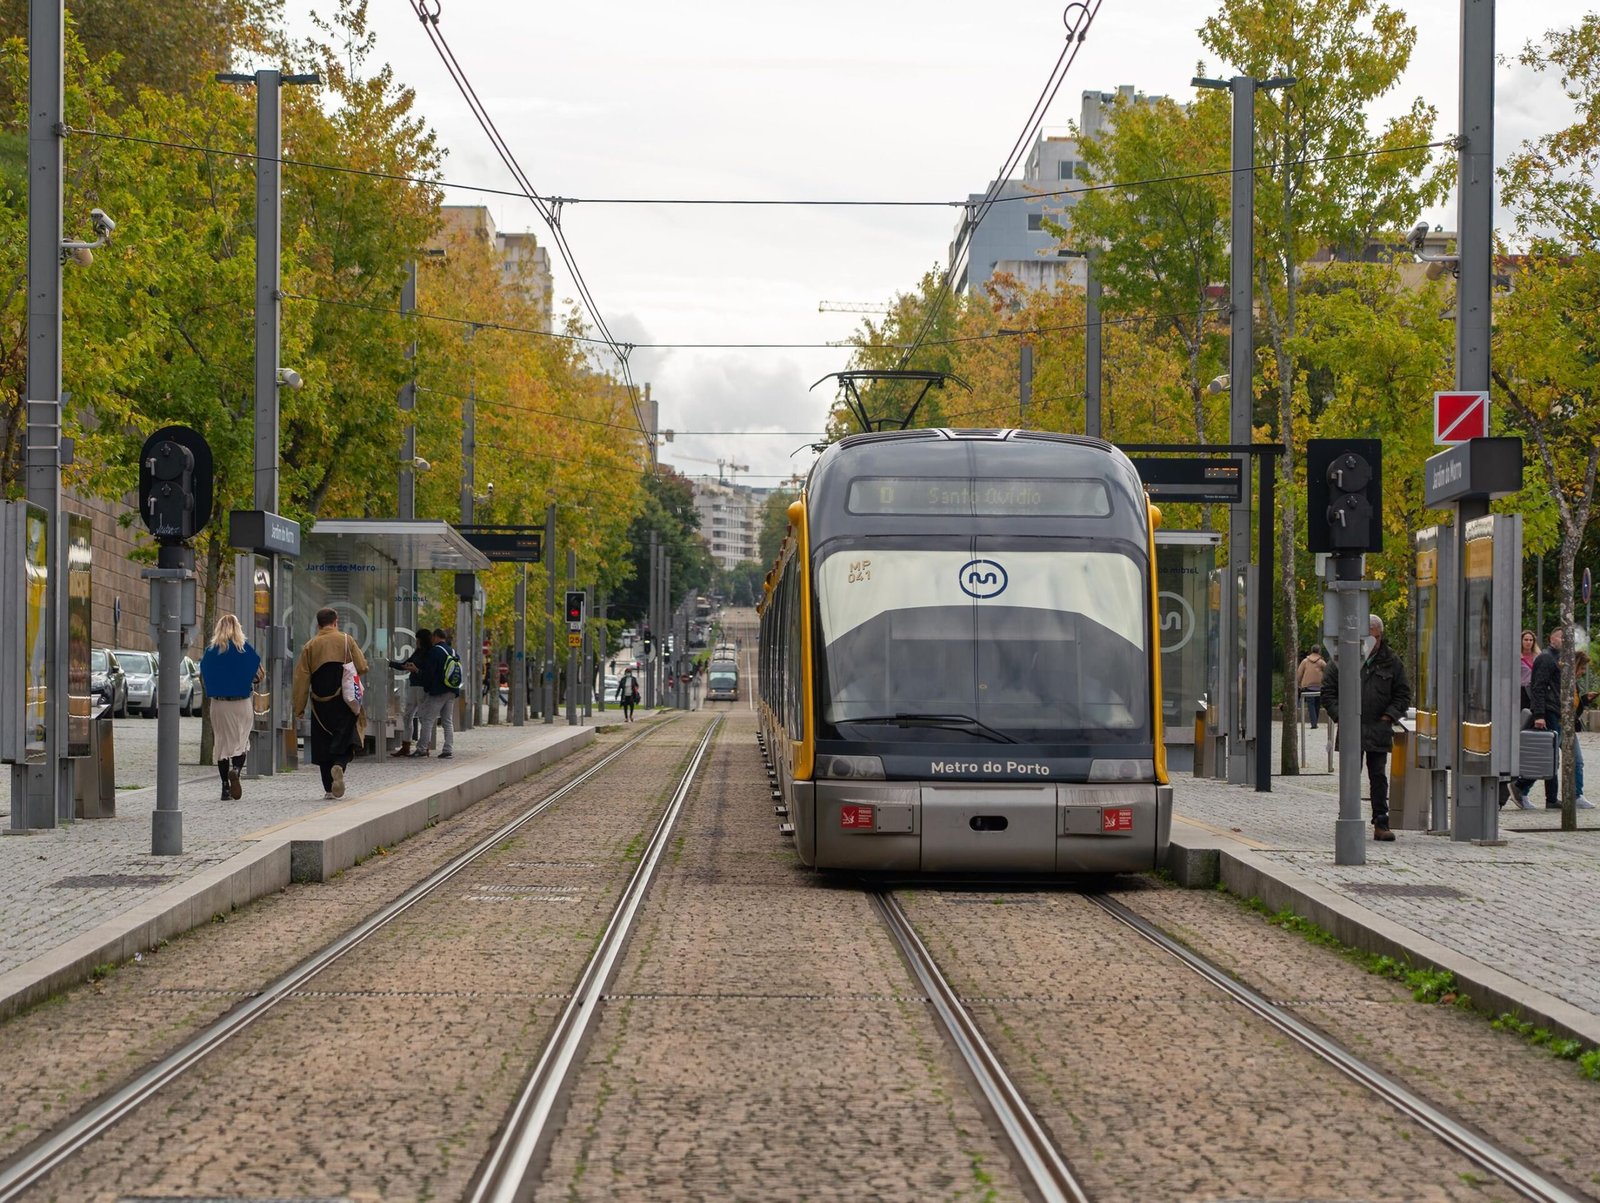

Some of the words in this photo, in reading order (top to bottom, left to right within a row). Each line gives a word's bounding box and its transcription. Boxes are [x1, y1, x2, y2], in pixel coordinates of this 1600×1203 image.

[349, 563, 376, 572] Morro
[849, 560, 872, 572] MP
[847, 570, 872, 584] 041
[931, 761, 978, 774] Metro
[983, 761, 1002, 773] do
[1007, 761, 1050, 776] Porto
